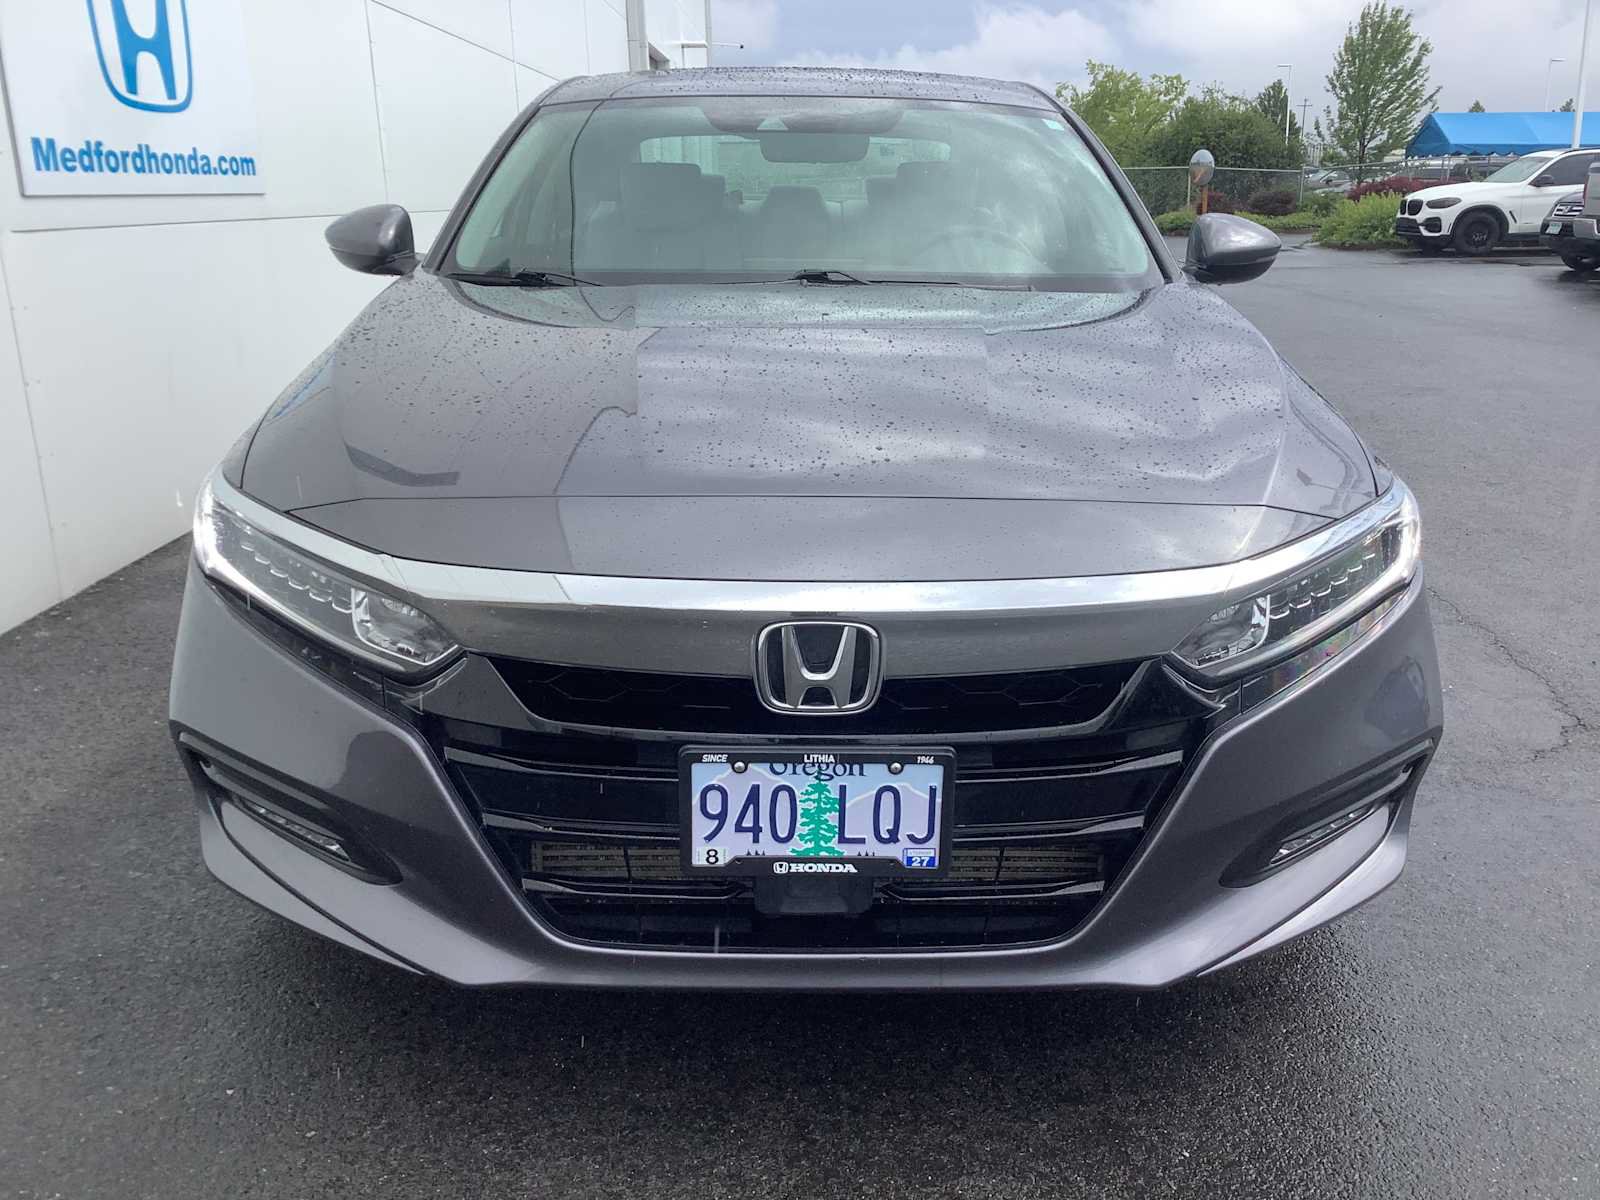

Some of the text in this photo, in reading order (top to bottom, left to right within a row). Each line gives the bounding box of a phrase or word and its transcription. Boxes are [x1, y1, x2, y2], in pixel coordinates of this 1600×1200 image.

[31, 136, 256, 176] Medfordhonda.com
[702, 754, 728, 763] SINCE
[803, 754, 835, 763] LITHIA
[769, 762, 866, 781] Oregon
[699, 783, 938, 845] 940 LQJ
[705, 848, 719, 865] 8
[911, 856, 930, 867] 27
[789, 863, 858, 873] HONDA
